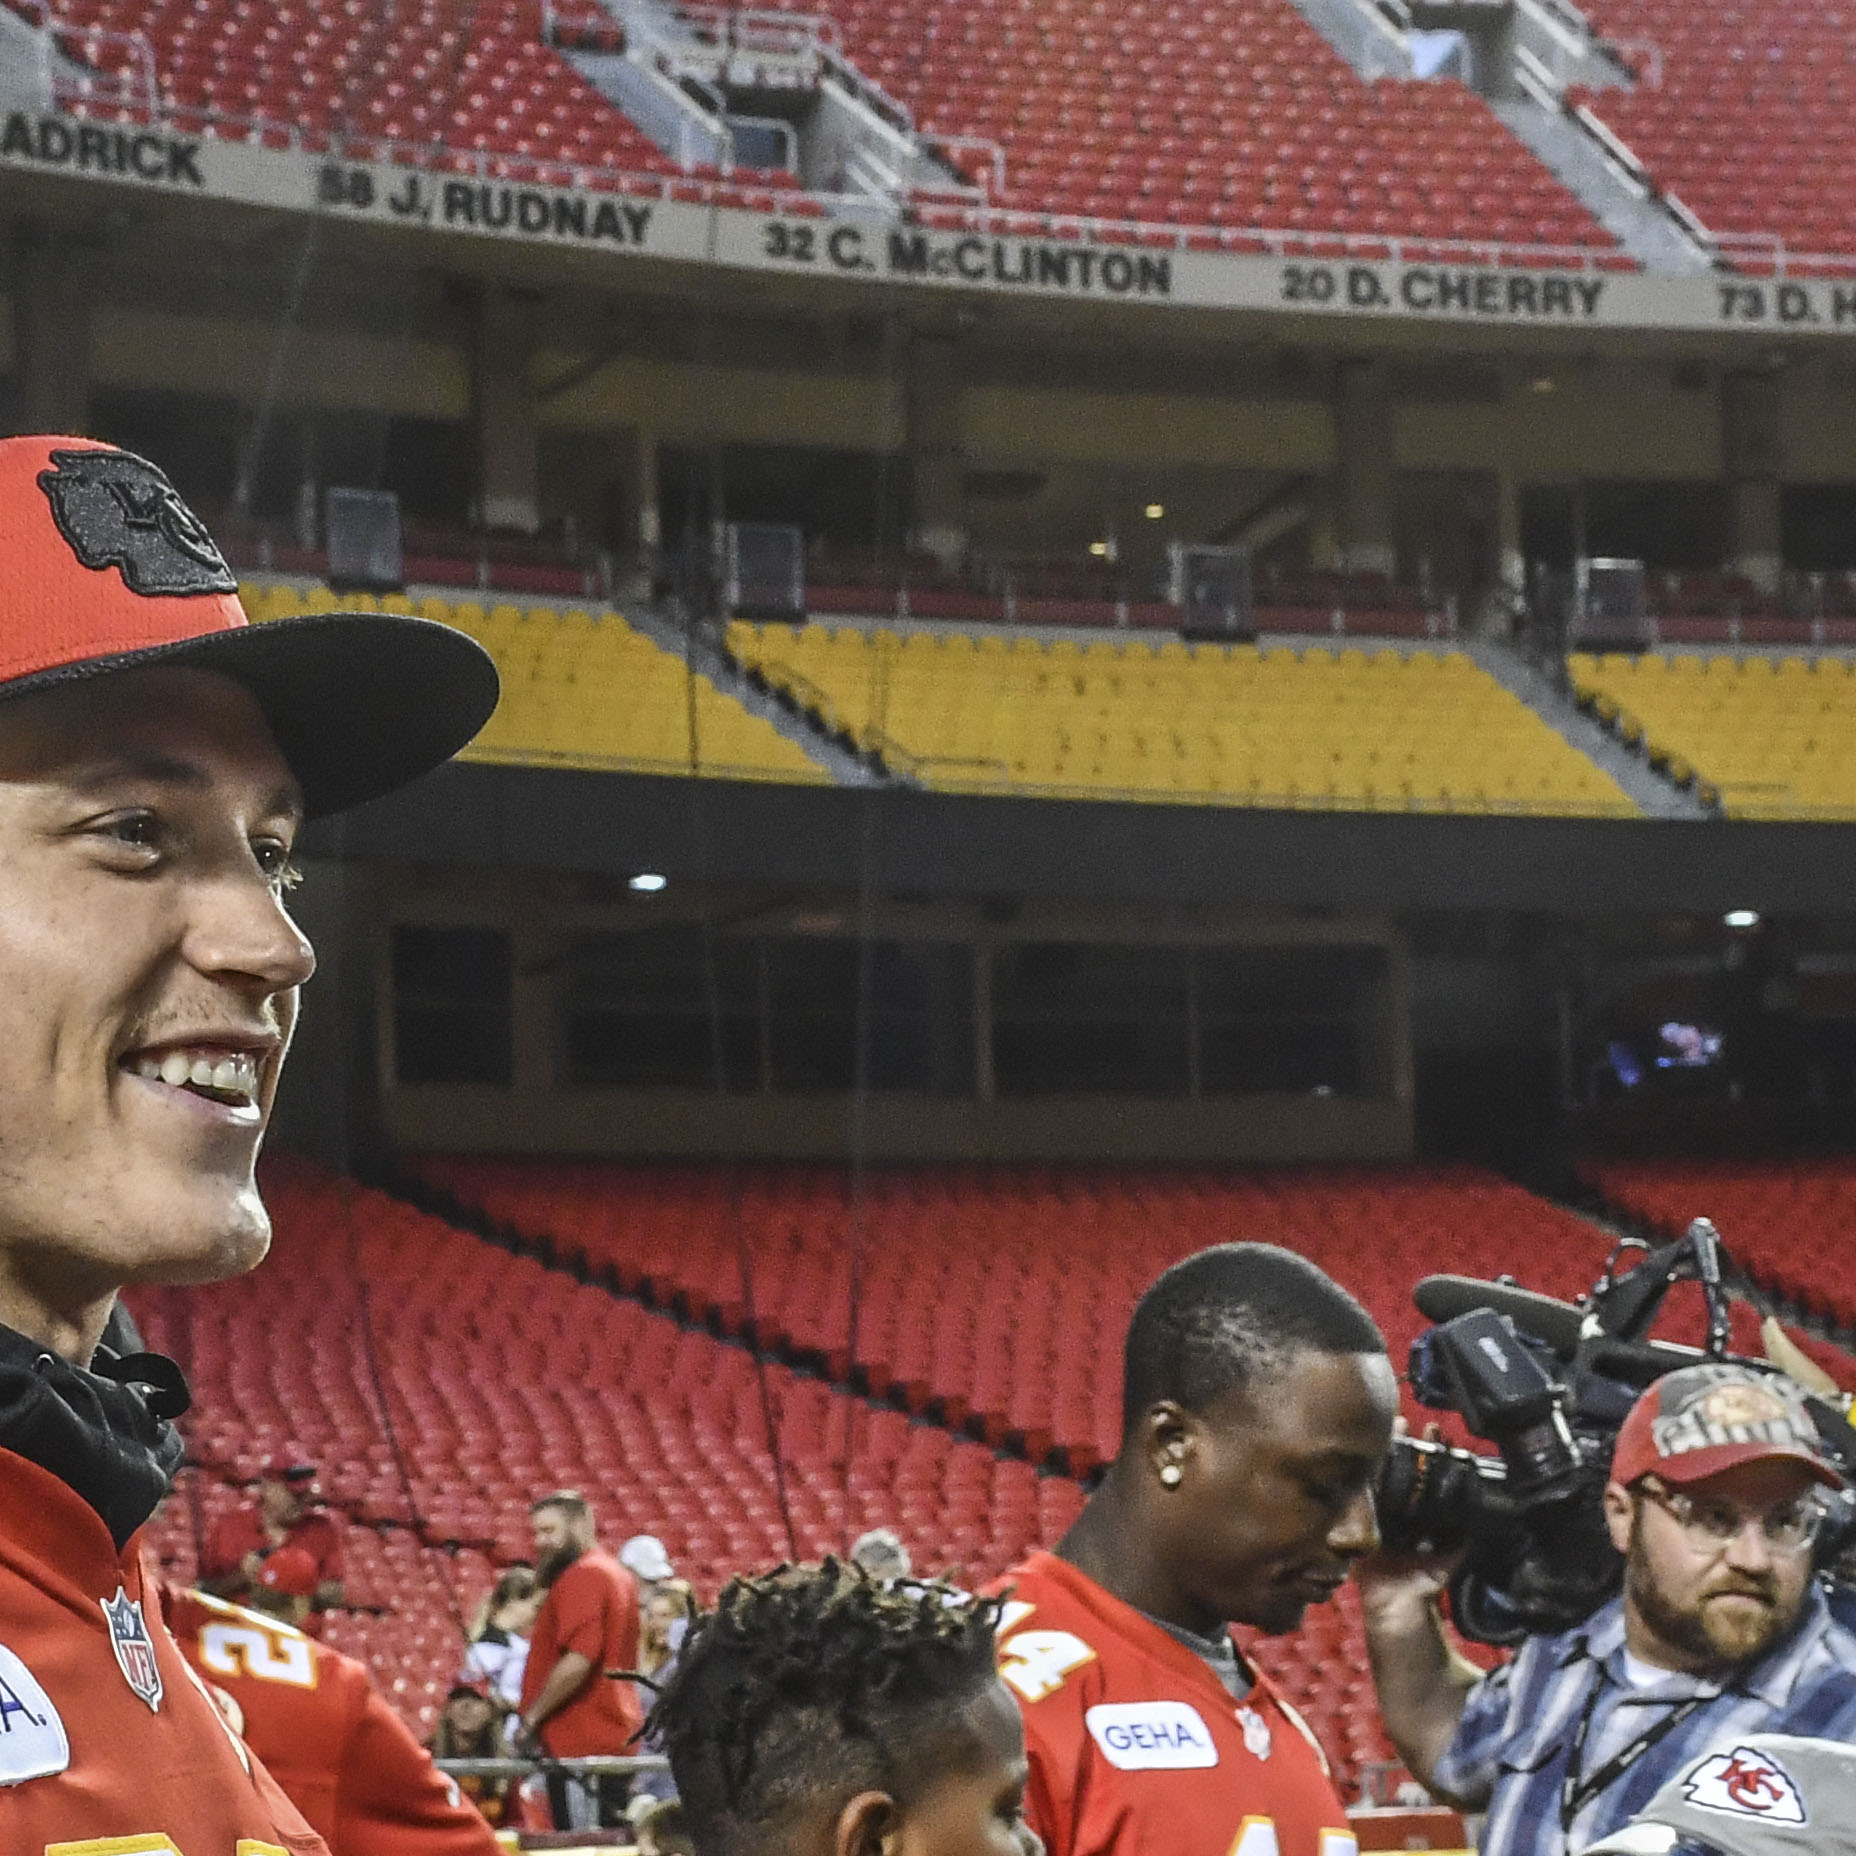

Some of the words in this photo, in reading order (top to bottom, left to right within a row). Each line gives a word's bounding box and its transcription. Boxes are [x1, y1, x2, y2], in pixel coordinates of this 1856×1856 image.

[445, 181, 652, 244] RUDNAY
[826, 227, 876, 272] C.
[1347, 268, 1390, 306] D.
[1400, 269, 1603, 316] CHERRY
